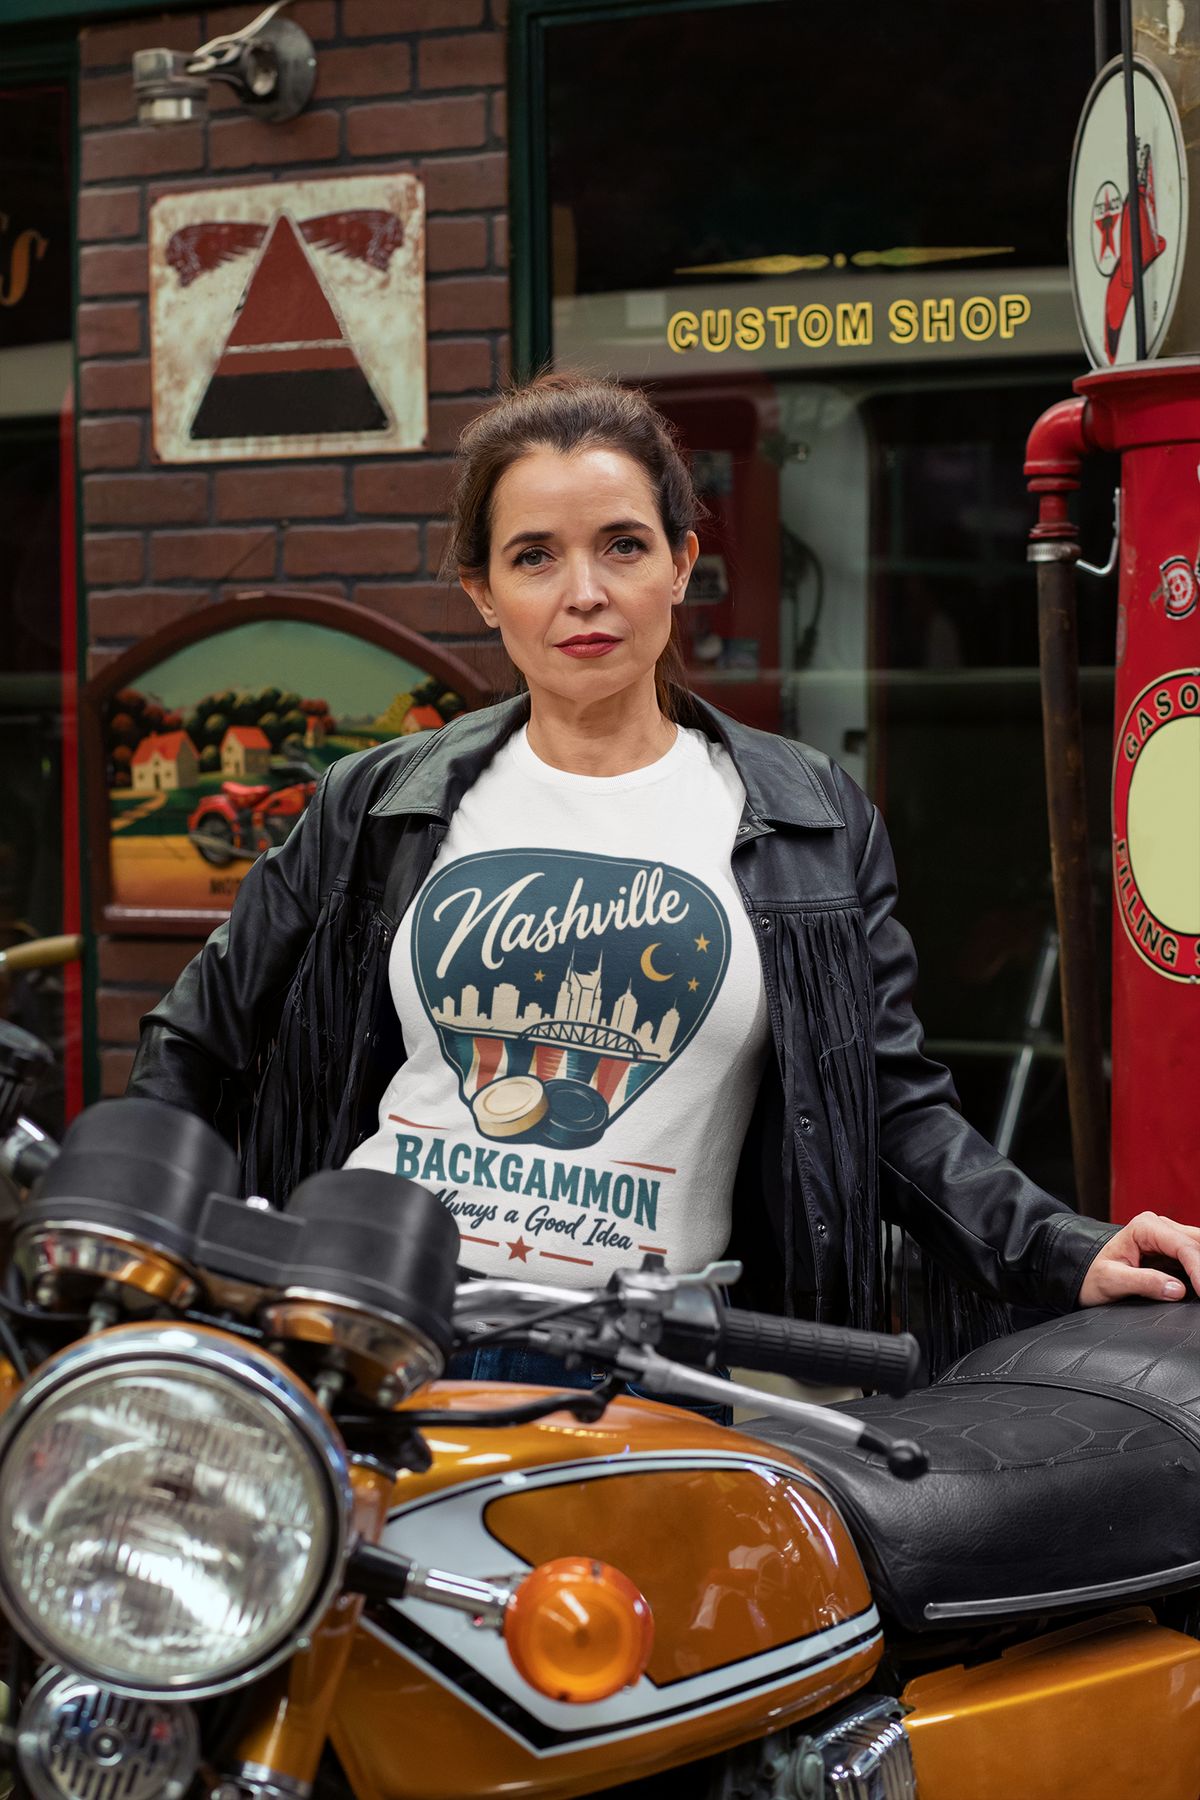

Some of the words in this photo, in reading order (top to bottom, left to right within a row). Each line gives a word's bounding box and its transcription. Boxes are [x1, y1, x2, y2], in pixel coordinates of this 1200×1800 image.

[667, 302, 873, 353] CUSTOM
[888, 294, 1031, 344] SHOP
[1123, 682, 1200, 763] GASO
[433, 867, 690, 979] Nashville
[1117, 838, 1179, 967] FILLING
[395, 1133, 661, 1232] BACKGAMMON
[503, 1209, 520, 1223] a
[525, 1204, 587, 1241] Good
[582, 1217, 633, 1251] Idea
